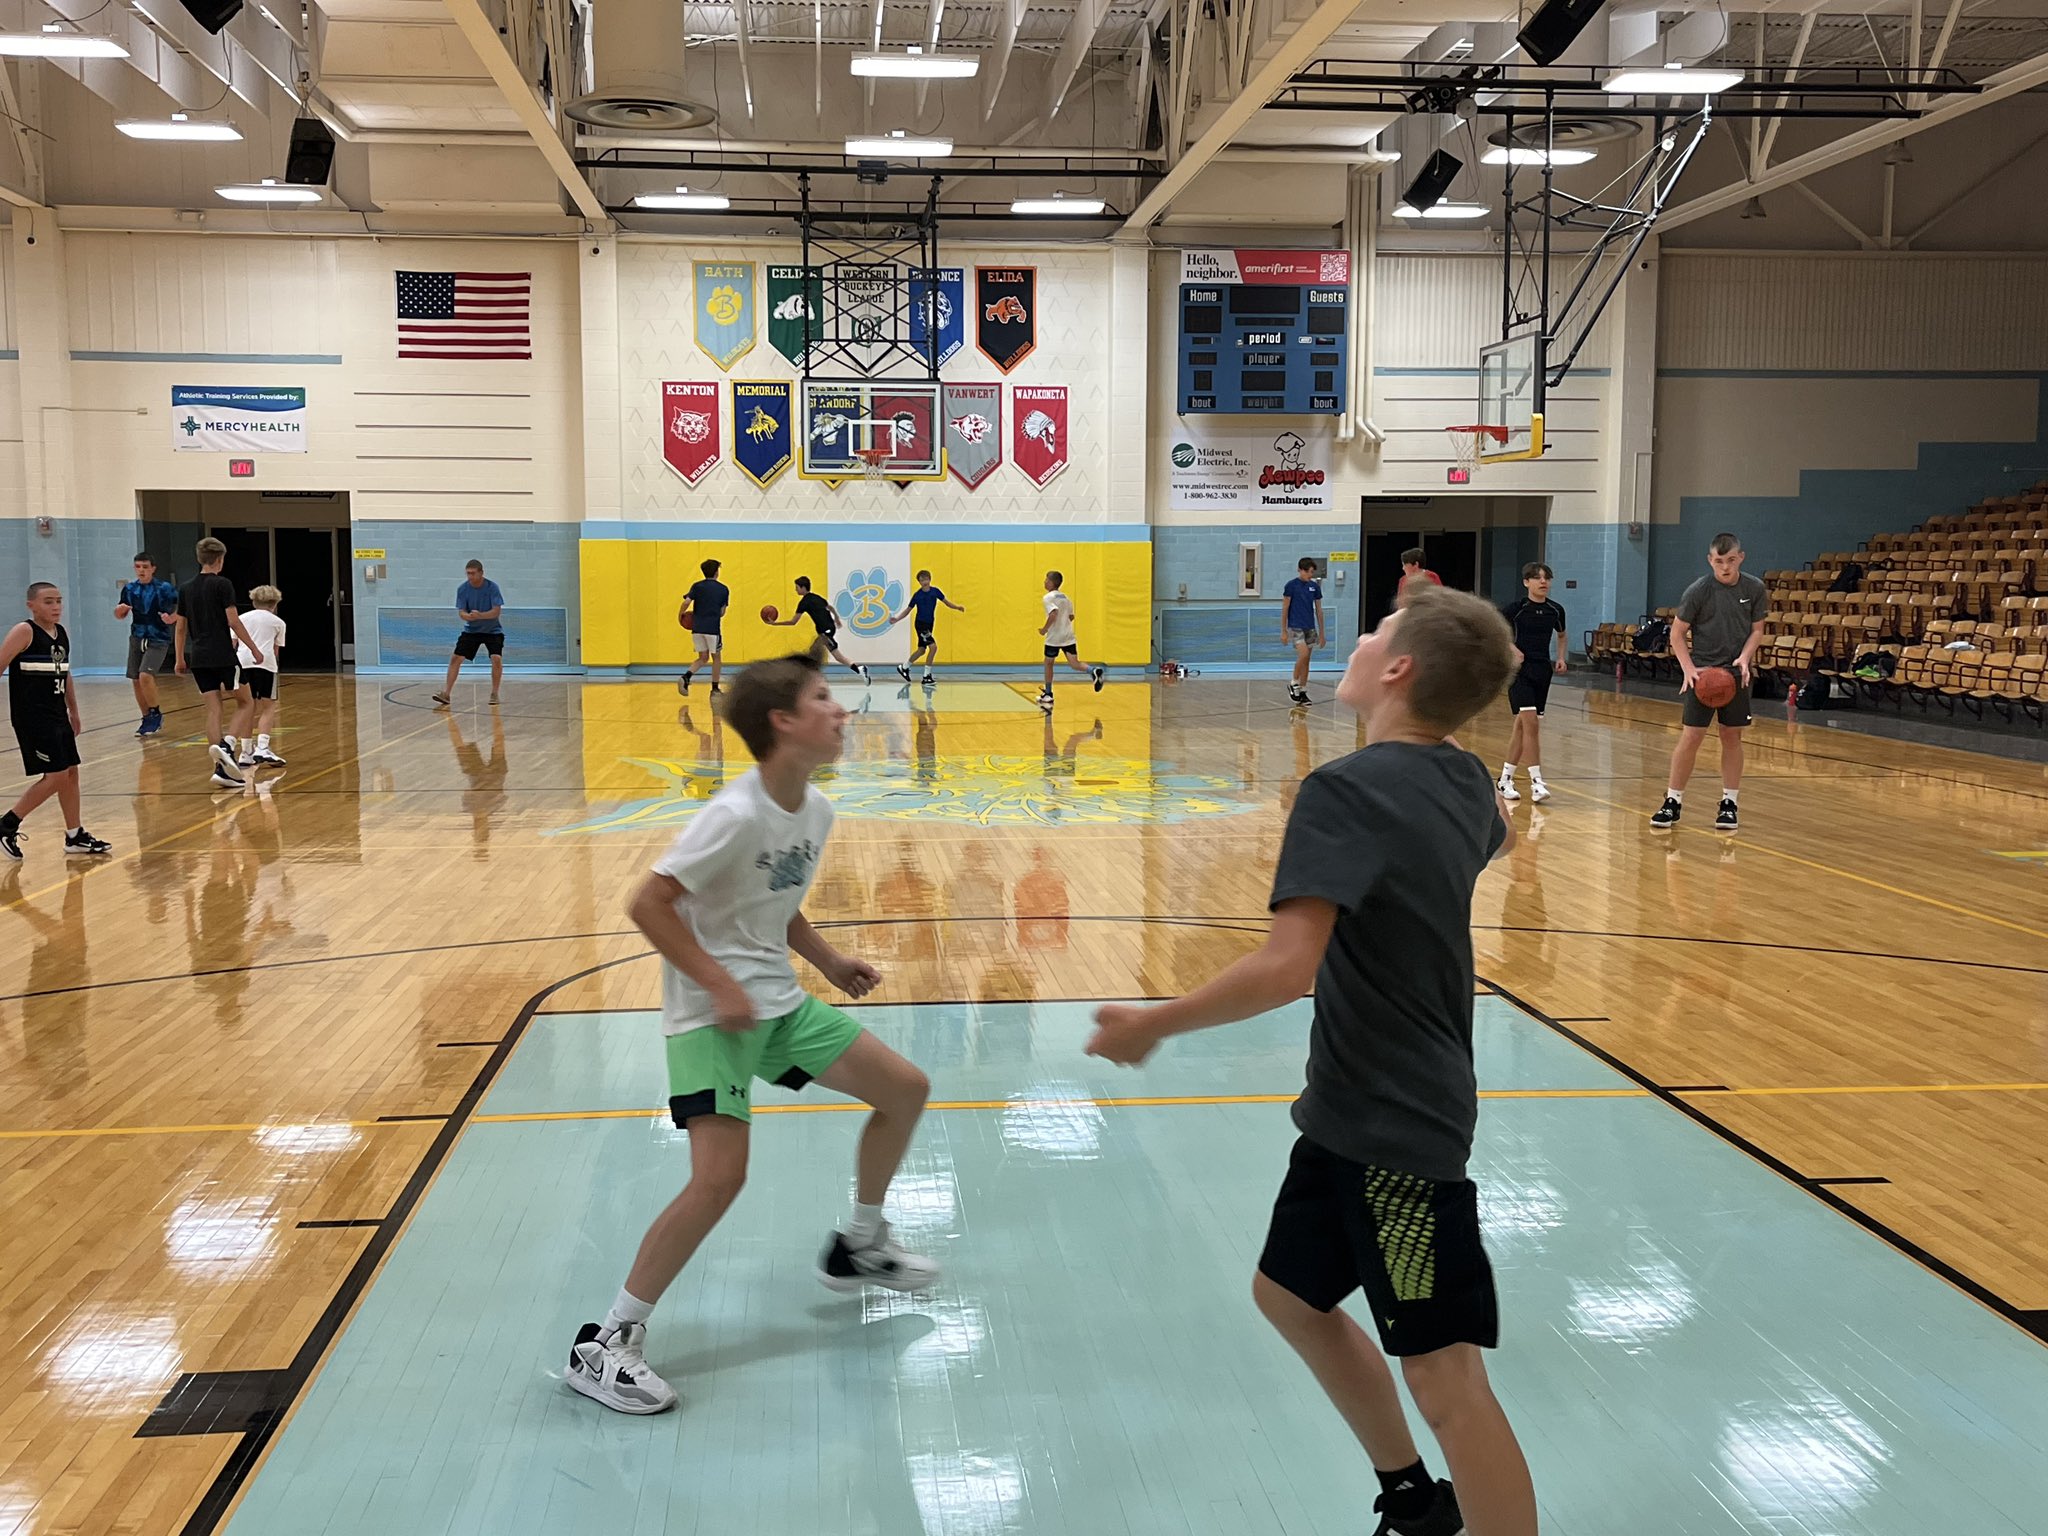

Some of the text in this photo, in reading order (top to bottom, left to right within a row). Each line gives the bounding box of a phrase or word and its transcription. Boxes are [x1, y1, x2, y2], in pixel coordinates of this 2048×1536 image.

[1186, 254, 1219, 267] Hello,
[704, 267, 743, 278] BATH
[772, 268, 818, 279] CELI
[842, 269, 889, 279] WESTERN
[1186, 267, 1238, 281] neighbor.
[1245, 263, 1294, 275] amerifirst
[987, 272, 1024, 283] ELIDA
[844, 282, 888, 291] BUCKEYE
[848, 294, 885, 303] LEAGUE
[1189, 289, 1217, 302] Home
[1310, 290, 1344, 303] Guests
[1249, 332, 1281, 346] period
[1248, 353, 1280, 366] player
[205, 392, 231, 400] Training
[666, 385, 715, 396] KENTON
[737, 385, 786, 396] MEMORIAL
[948, 388, 995, 399] VANWERT
[1015, 389, 1065, 400] WAPAKONETA
[1191, 396, 1212, 408] bout
[1313, 397, 1334, 409] bout
[1197, 448, 1233, 457] Midwest
[689, 454, 717, 480] WILDCATS
[1197, 458, 1251, 467] Electric, Inc.
[970, 457, 996, 482] COUGARS
[1259, 465, 1325, 489] Kewpee
[1172, 482, 1249, 490] www.midwestrec.com
[1261, 495, 1322, 506] Hamburgers
[852, 583, 891, 630] B
[53, 678, 66, 695] 34
